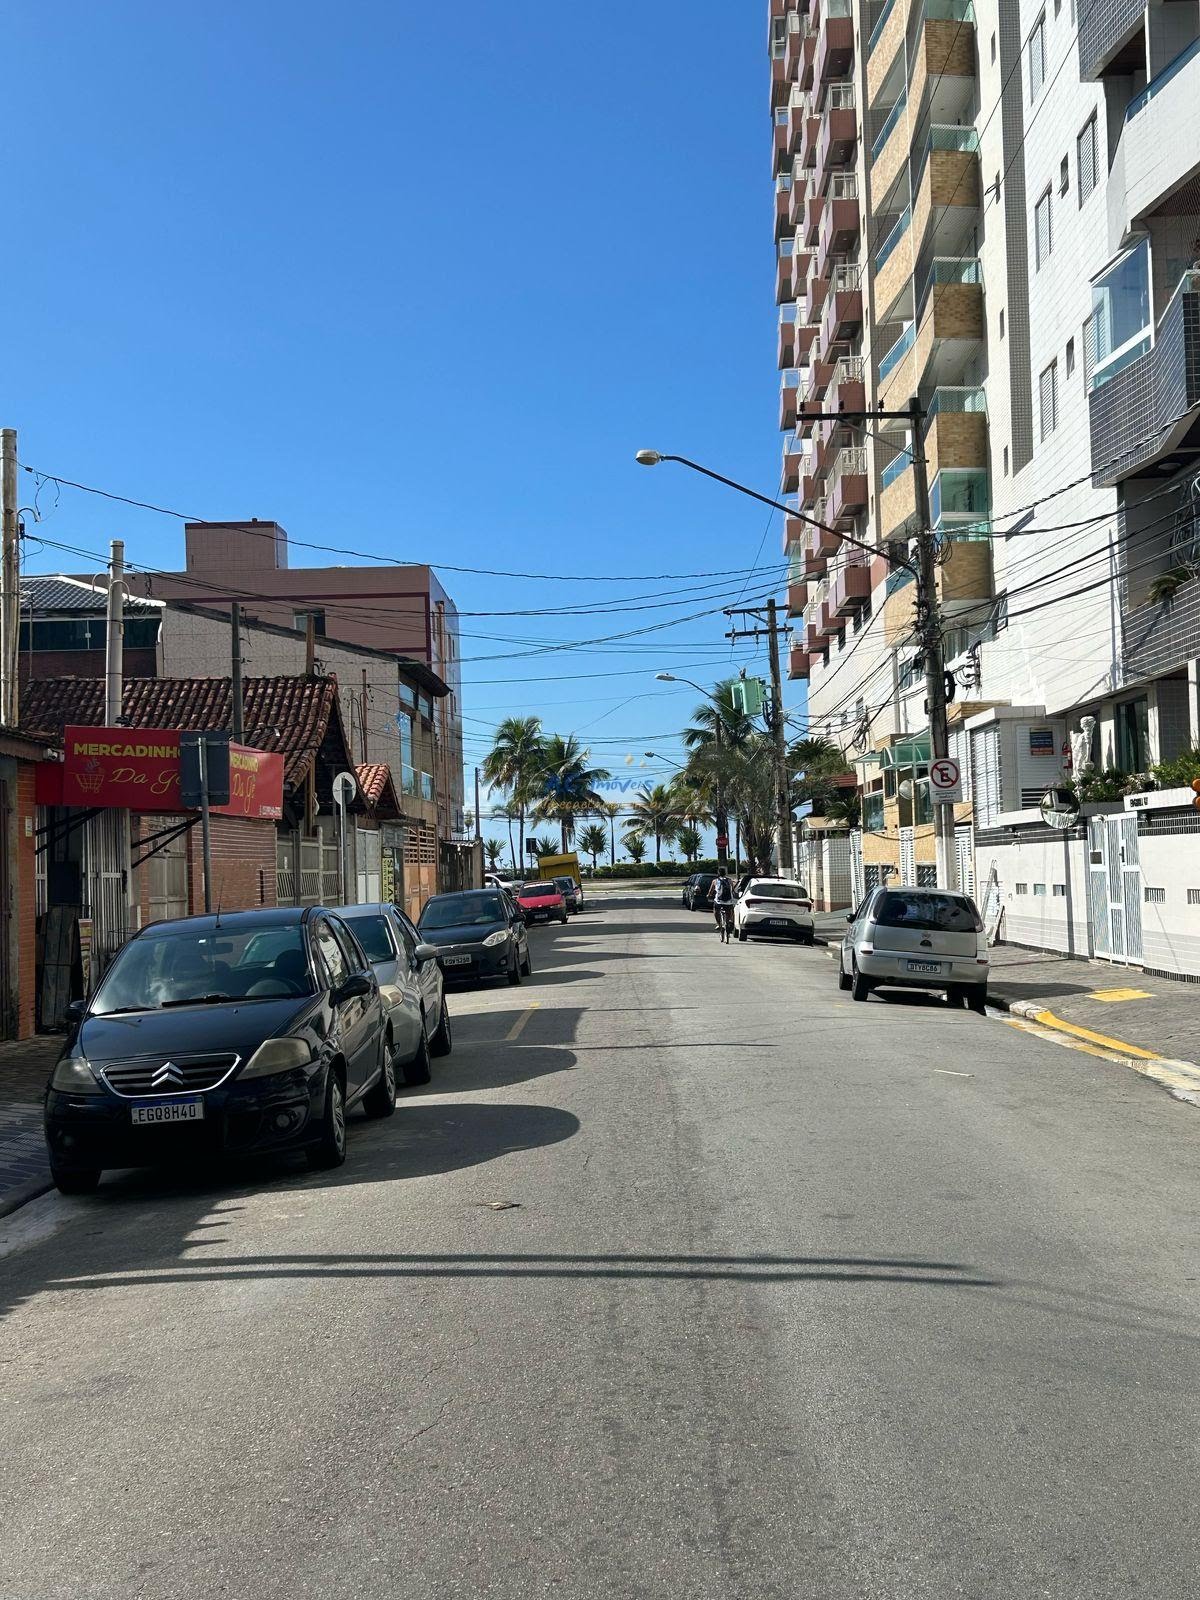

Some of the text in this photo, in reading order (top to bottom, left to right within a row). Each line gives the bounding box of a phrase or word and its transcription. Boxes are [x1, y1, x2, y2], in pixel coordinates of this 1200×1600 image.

[73, 743, 180, 758] MERCADINH
[108, 767, 149, 784] Da
[139, 1105, 196, 1121] EGQ8H40
